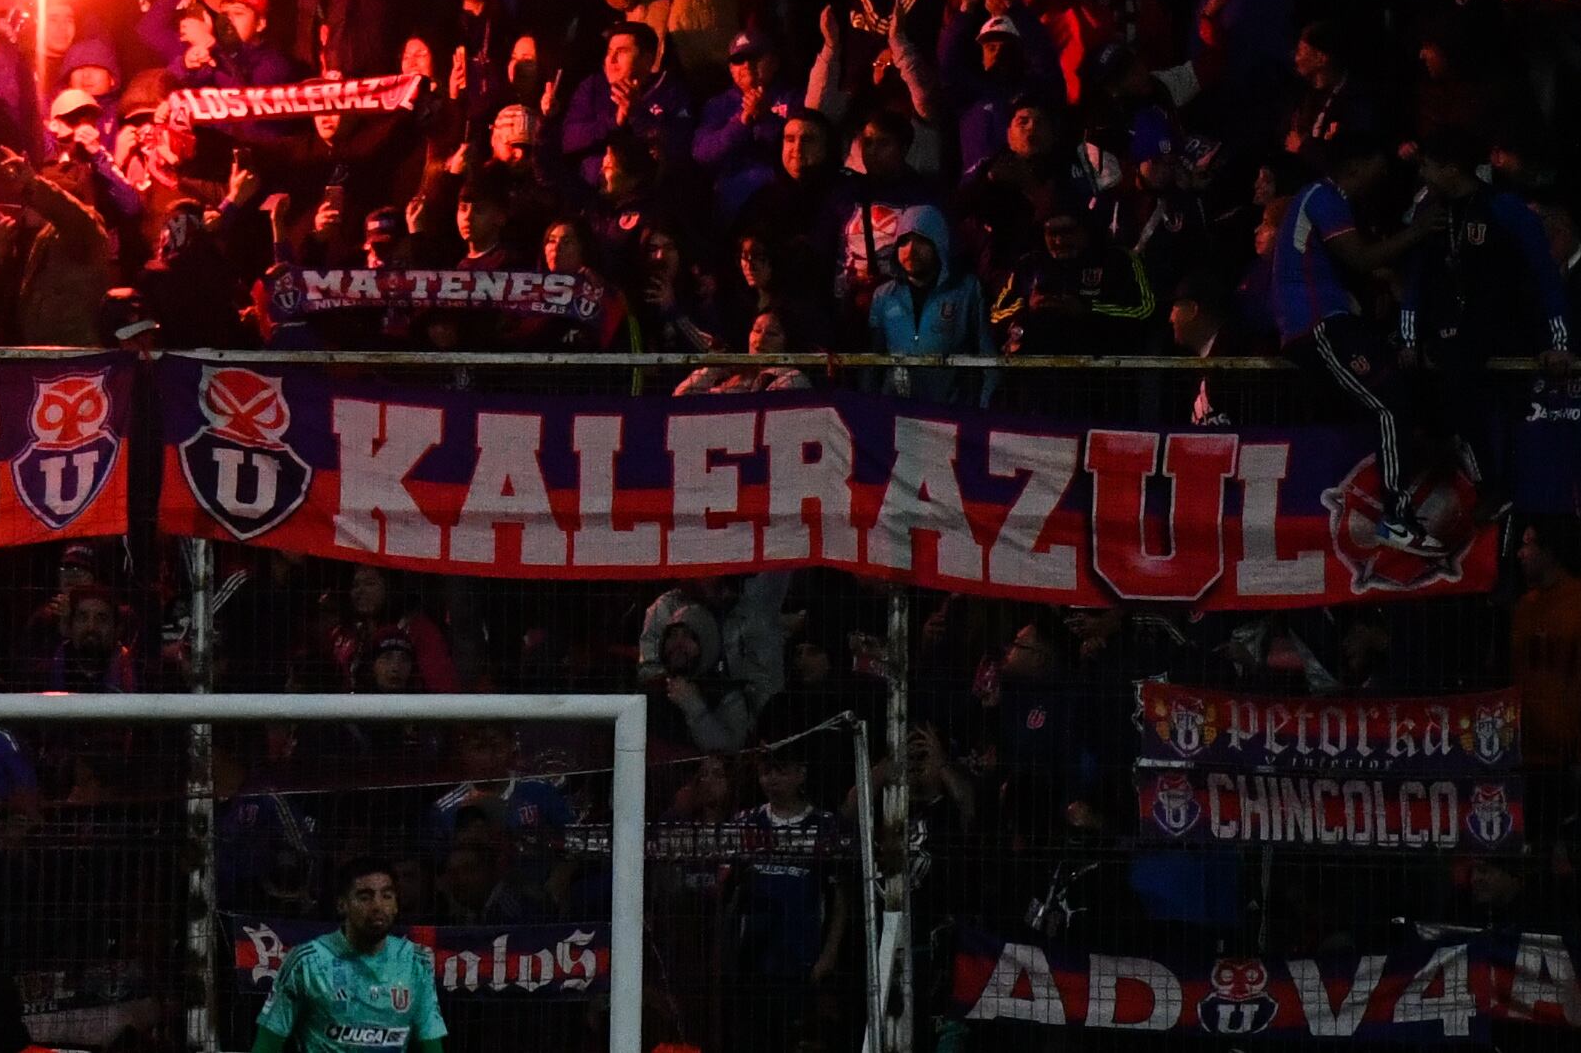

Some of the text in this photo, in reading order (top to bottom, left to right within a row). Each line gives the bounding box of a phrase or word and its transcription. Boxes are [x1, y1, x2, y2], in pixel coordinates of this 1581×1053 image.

[185, 87, 249, 120] LOS
[332, 398, 1325, 602] KALERAZUL
[1206, 772, 1459, 848] CHINCOLCO
